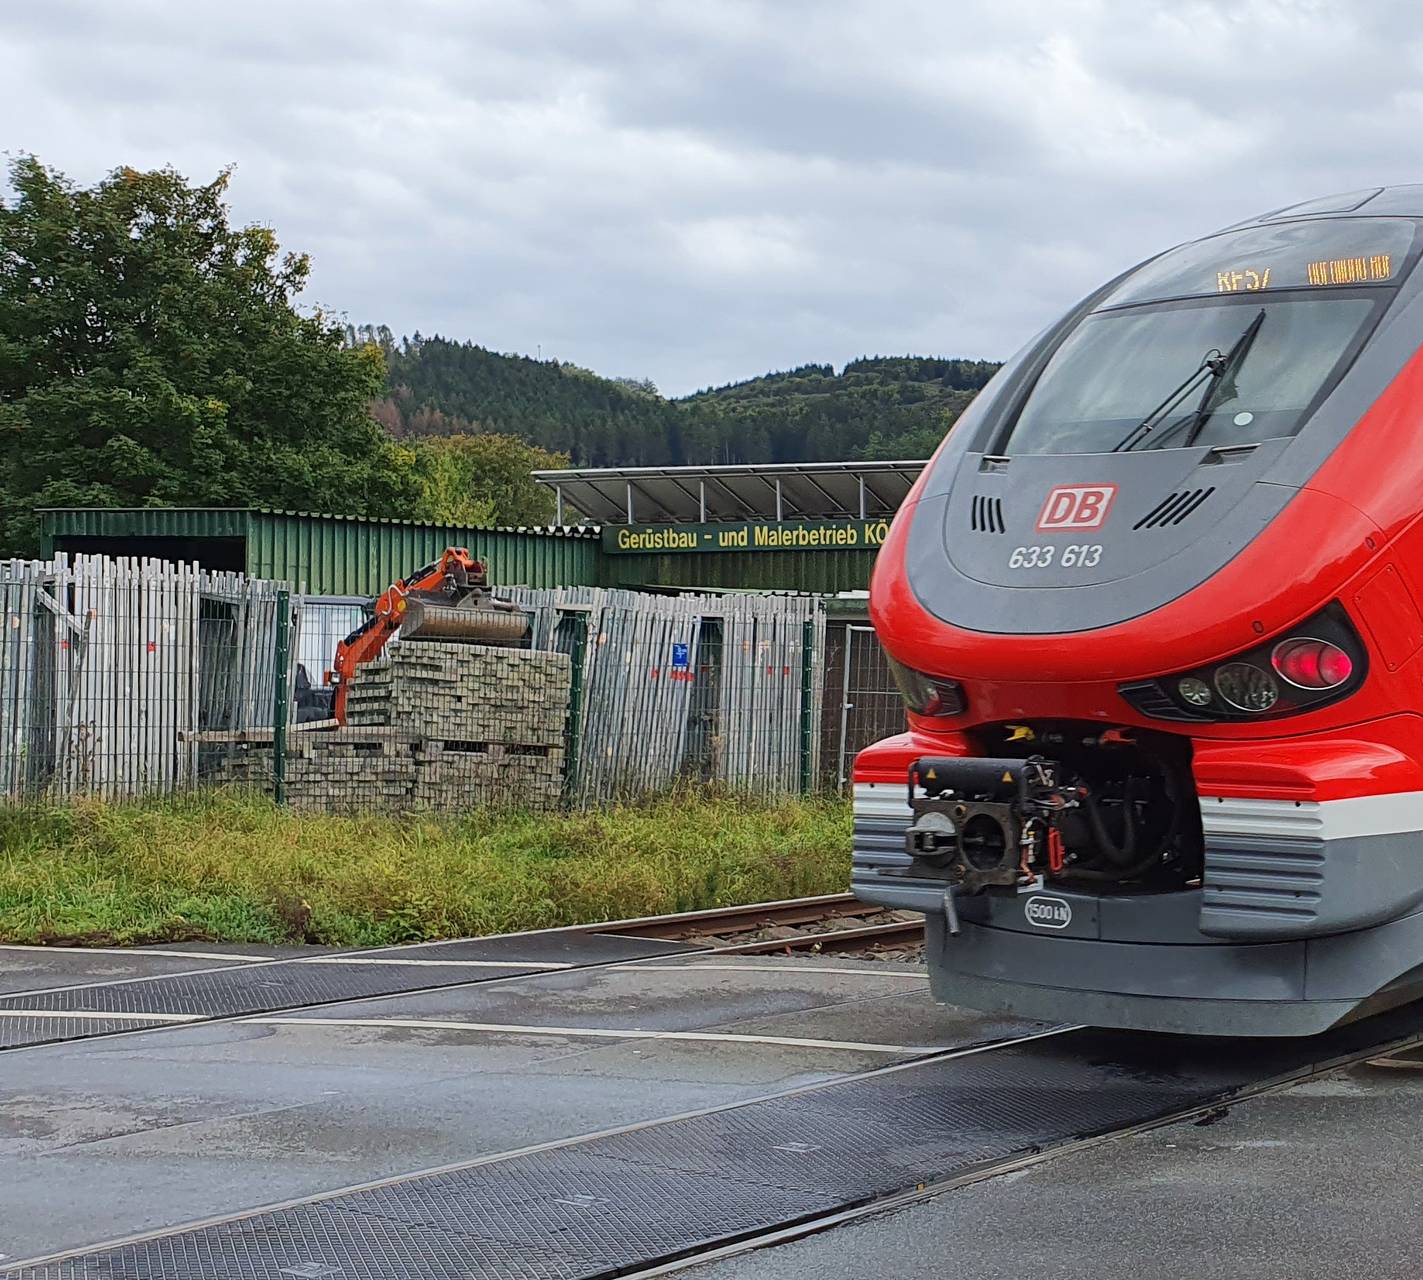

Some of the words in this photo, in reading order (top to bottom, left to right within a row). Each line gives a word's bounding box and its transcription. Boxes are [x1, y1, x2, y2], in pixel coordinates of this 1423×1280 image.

[1044, 491, 1105, 525] DB
[618, 528, 697, 549] Gerüstbau
[719, 526, 748, 546] und
[754, 524, 856, 546] Malerbetrieb
[1008, 545, 1055, 569] 633
[1061, 544, 1103, 568] 613
